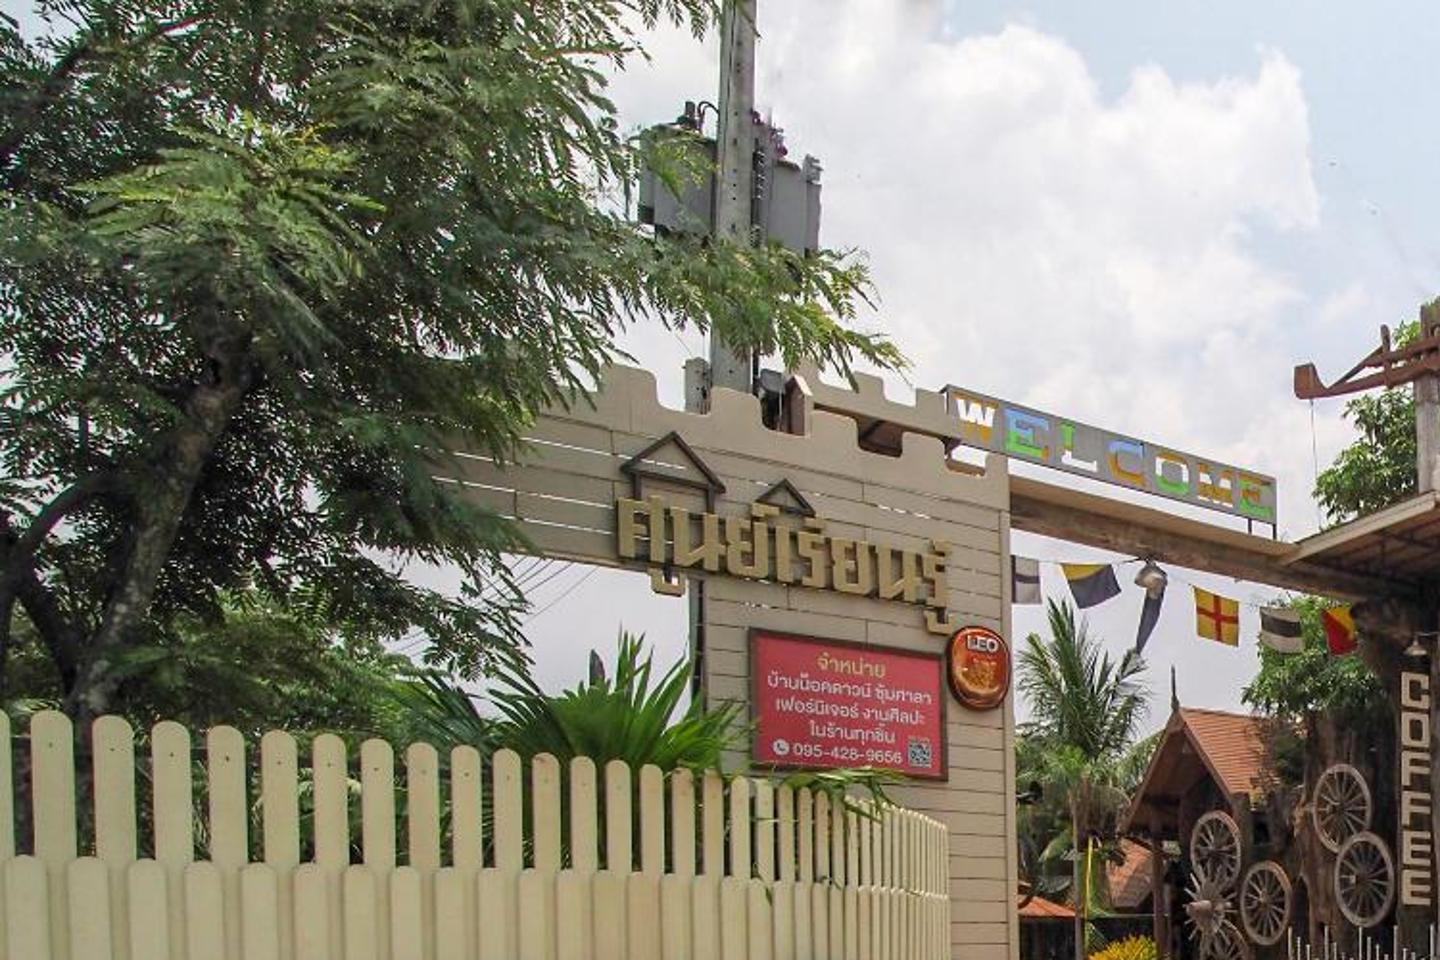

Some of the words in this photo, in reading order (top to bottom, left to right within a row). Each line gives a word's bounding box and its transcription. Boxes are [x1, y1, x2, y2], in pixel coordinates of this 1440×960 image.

[954, 391, 1275, 519] WELCOME
[816, 652, 887, 678] จำหน่าย
[967, 634, 999, 653] LEO
[1401, 671, 1431, 906] COFFEE
